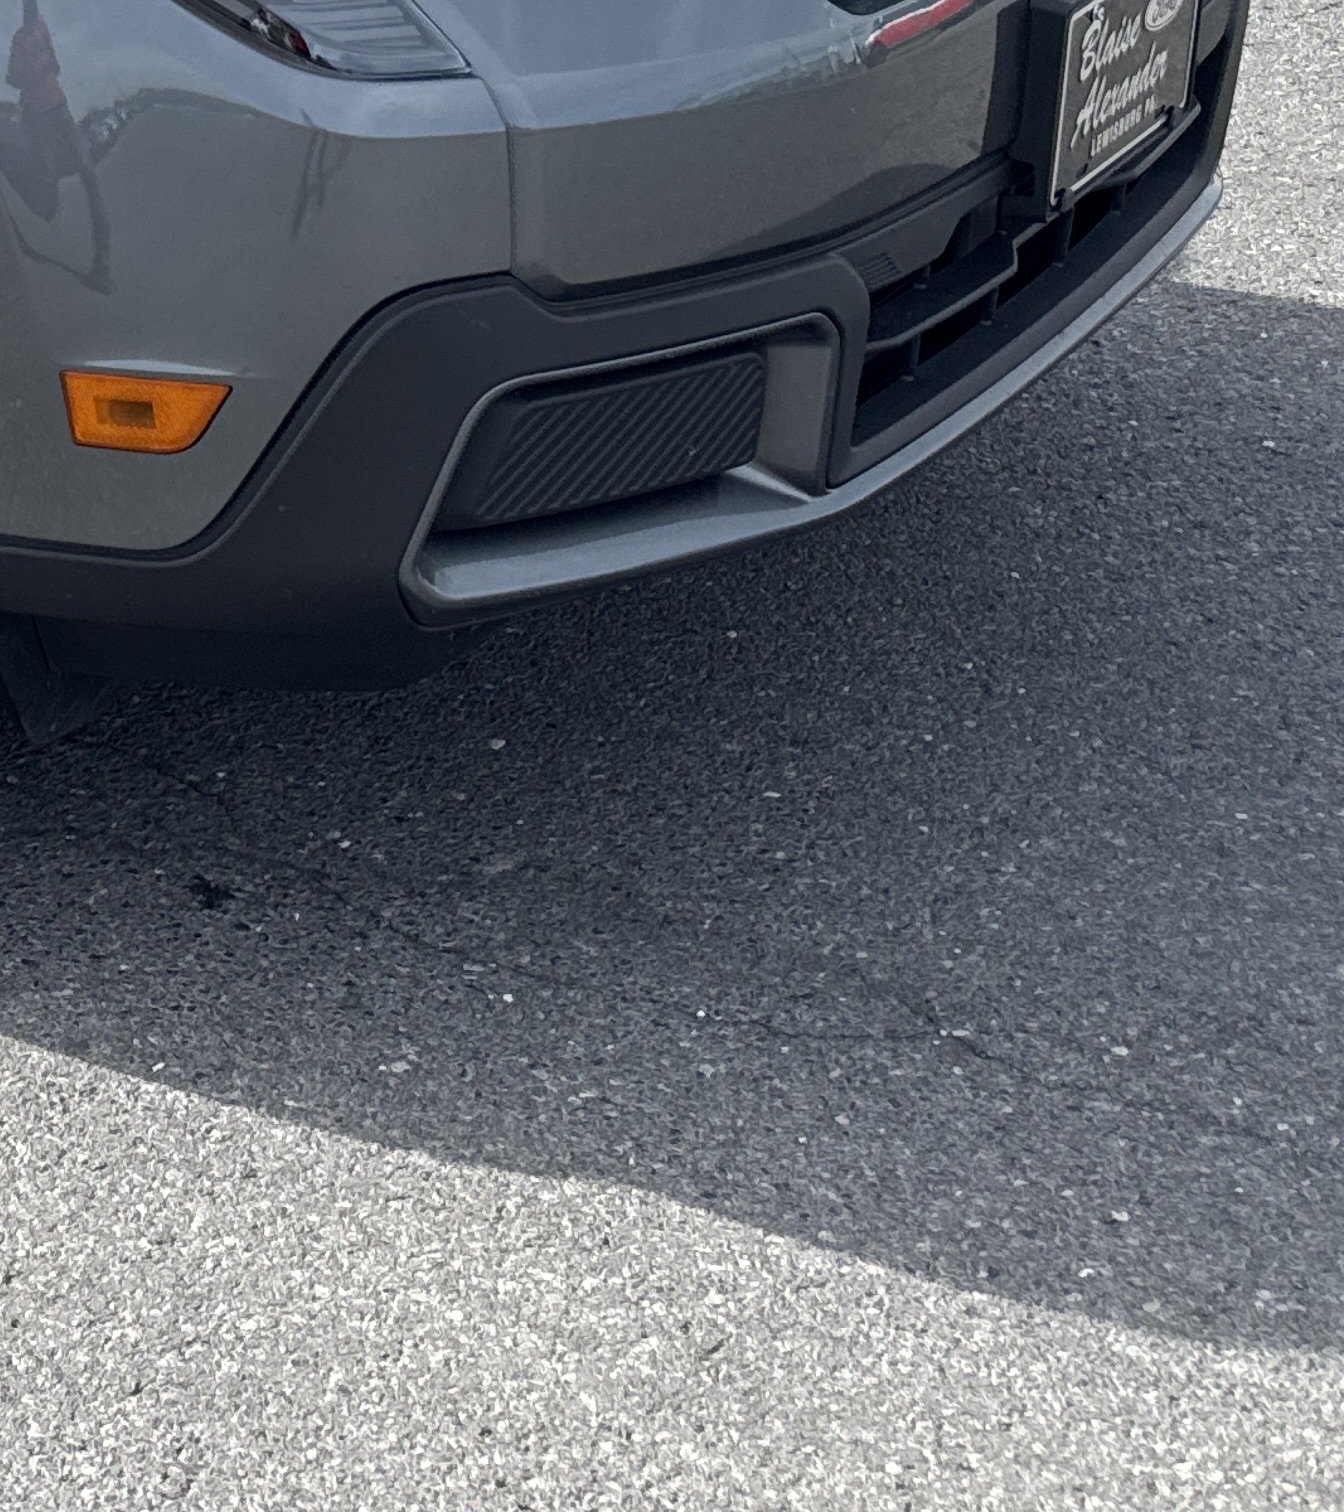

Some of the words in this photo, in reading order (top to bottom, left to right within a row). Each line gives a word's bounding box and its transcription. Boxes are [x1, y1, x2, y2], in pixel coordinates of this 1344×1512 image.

[1079, 12, 1143, 83] Blaise
[1070, 41, 1168, 150] Alexander
[1089, 104, 1143, 159] LEWISBURG
